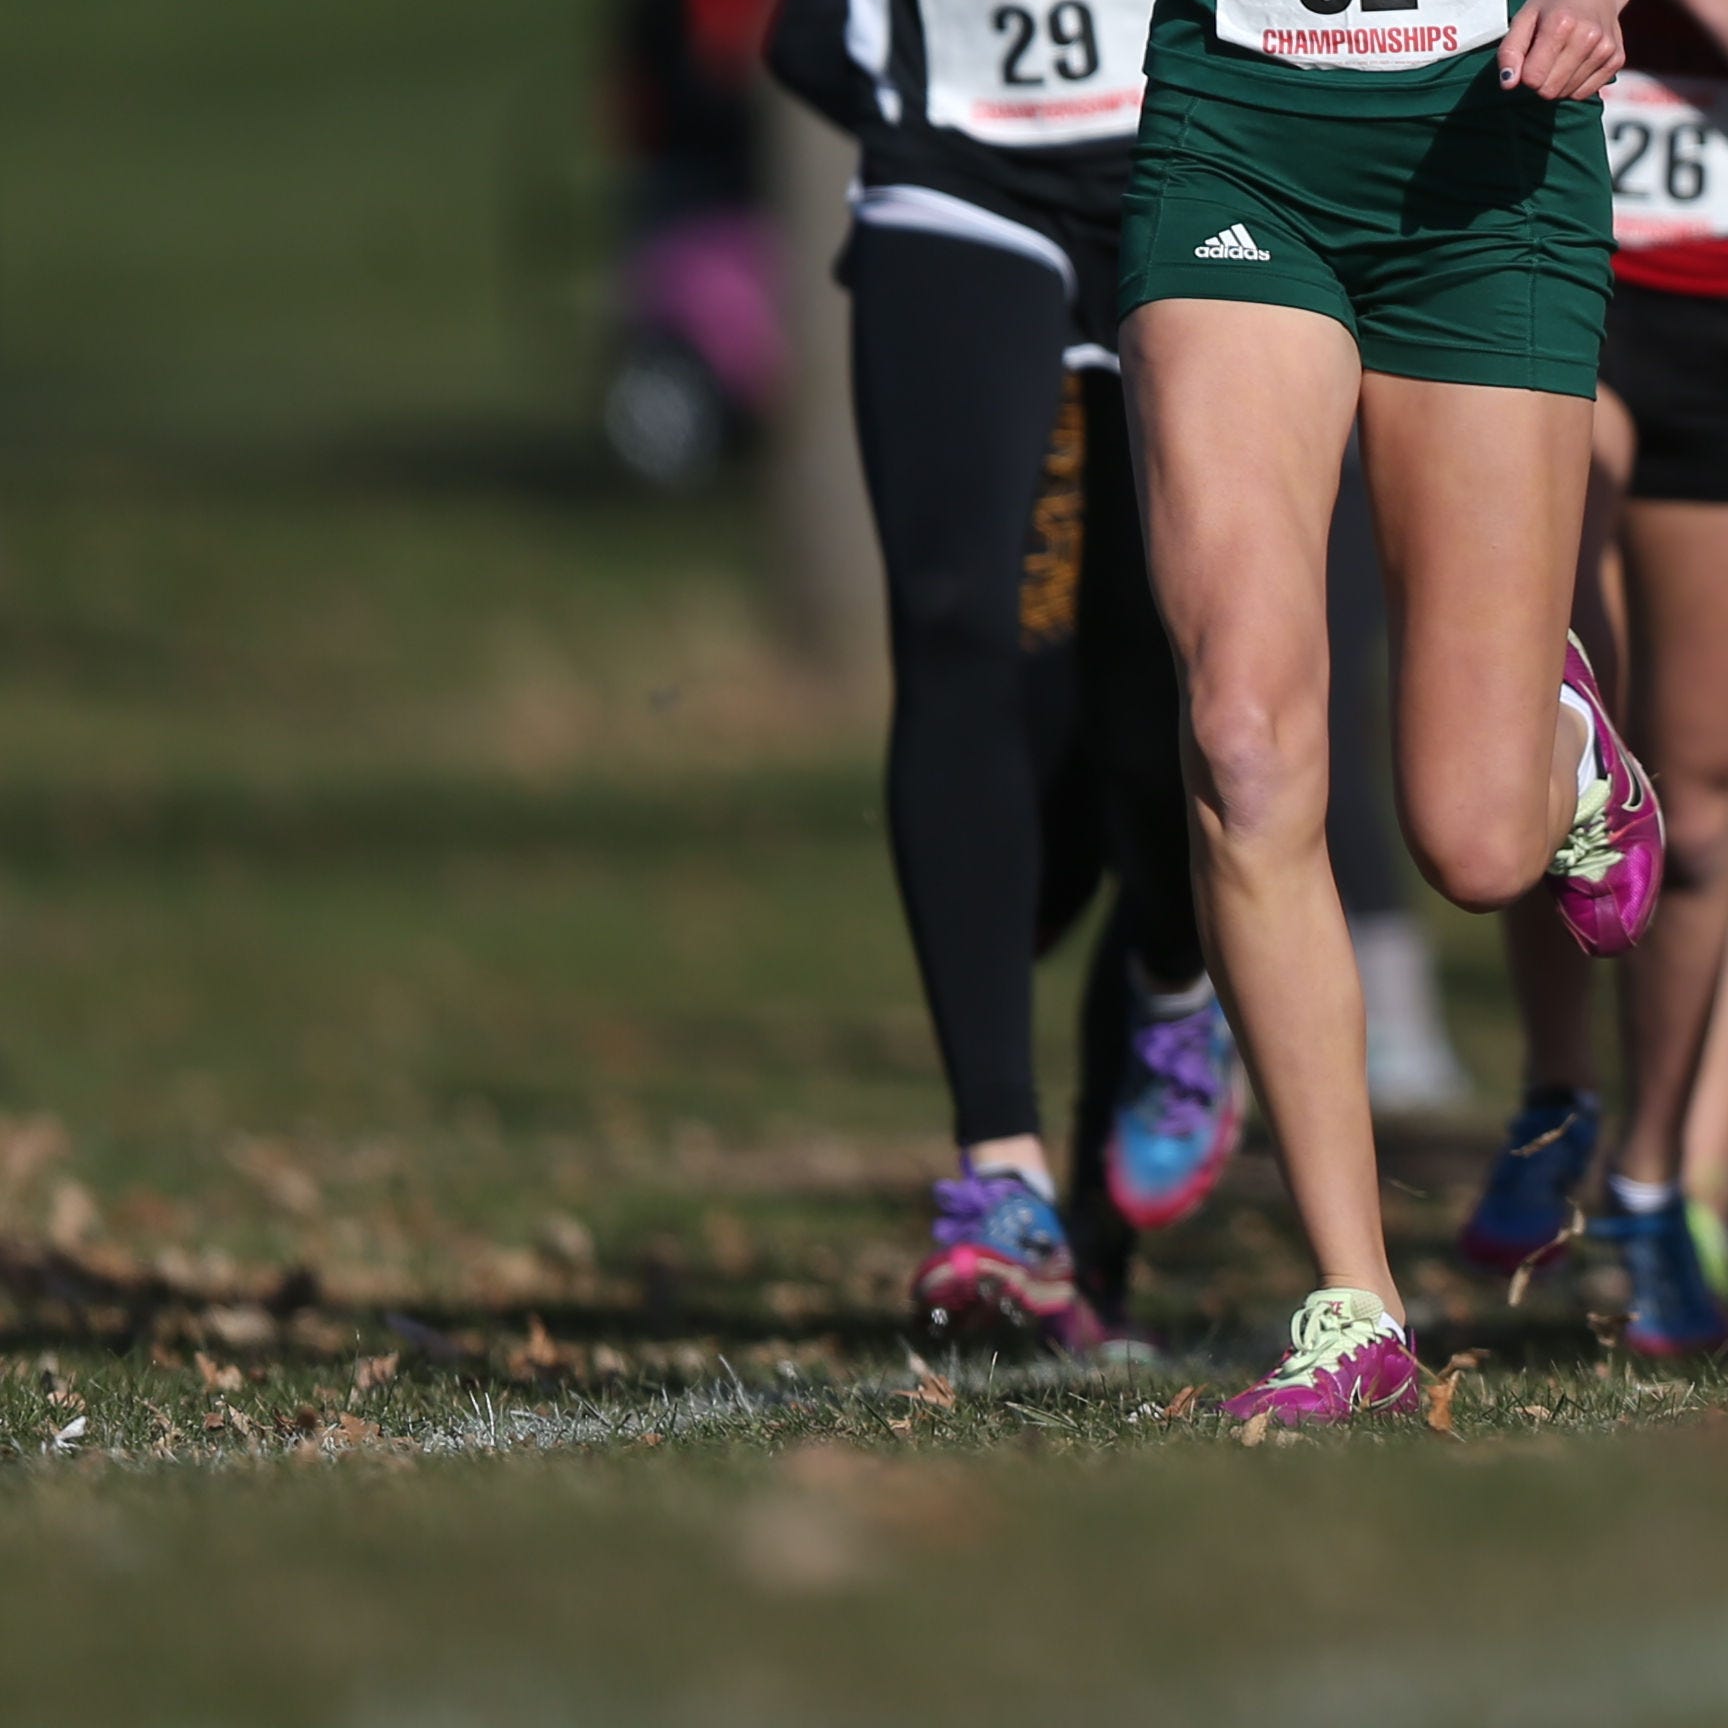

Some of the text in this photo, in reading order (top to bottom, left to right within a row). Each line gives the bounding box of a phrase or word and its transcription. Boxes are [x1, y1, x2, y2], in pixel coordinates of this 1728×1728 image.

[991, 0, 1100, 87] 29
[1262, 25, 1459, 55] CHAMPIONSHIPS
[1609, 121, 1706, 201] 26
[1194, 242, 1271, 262] adidas
